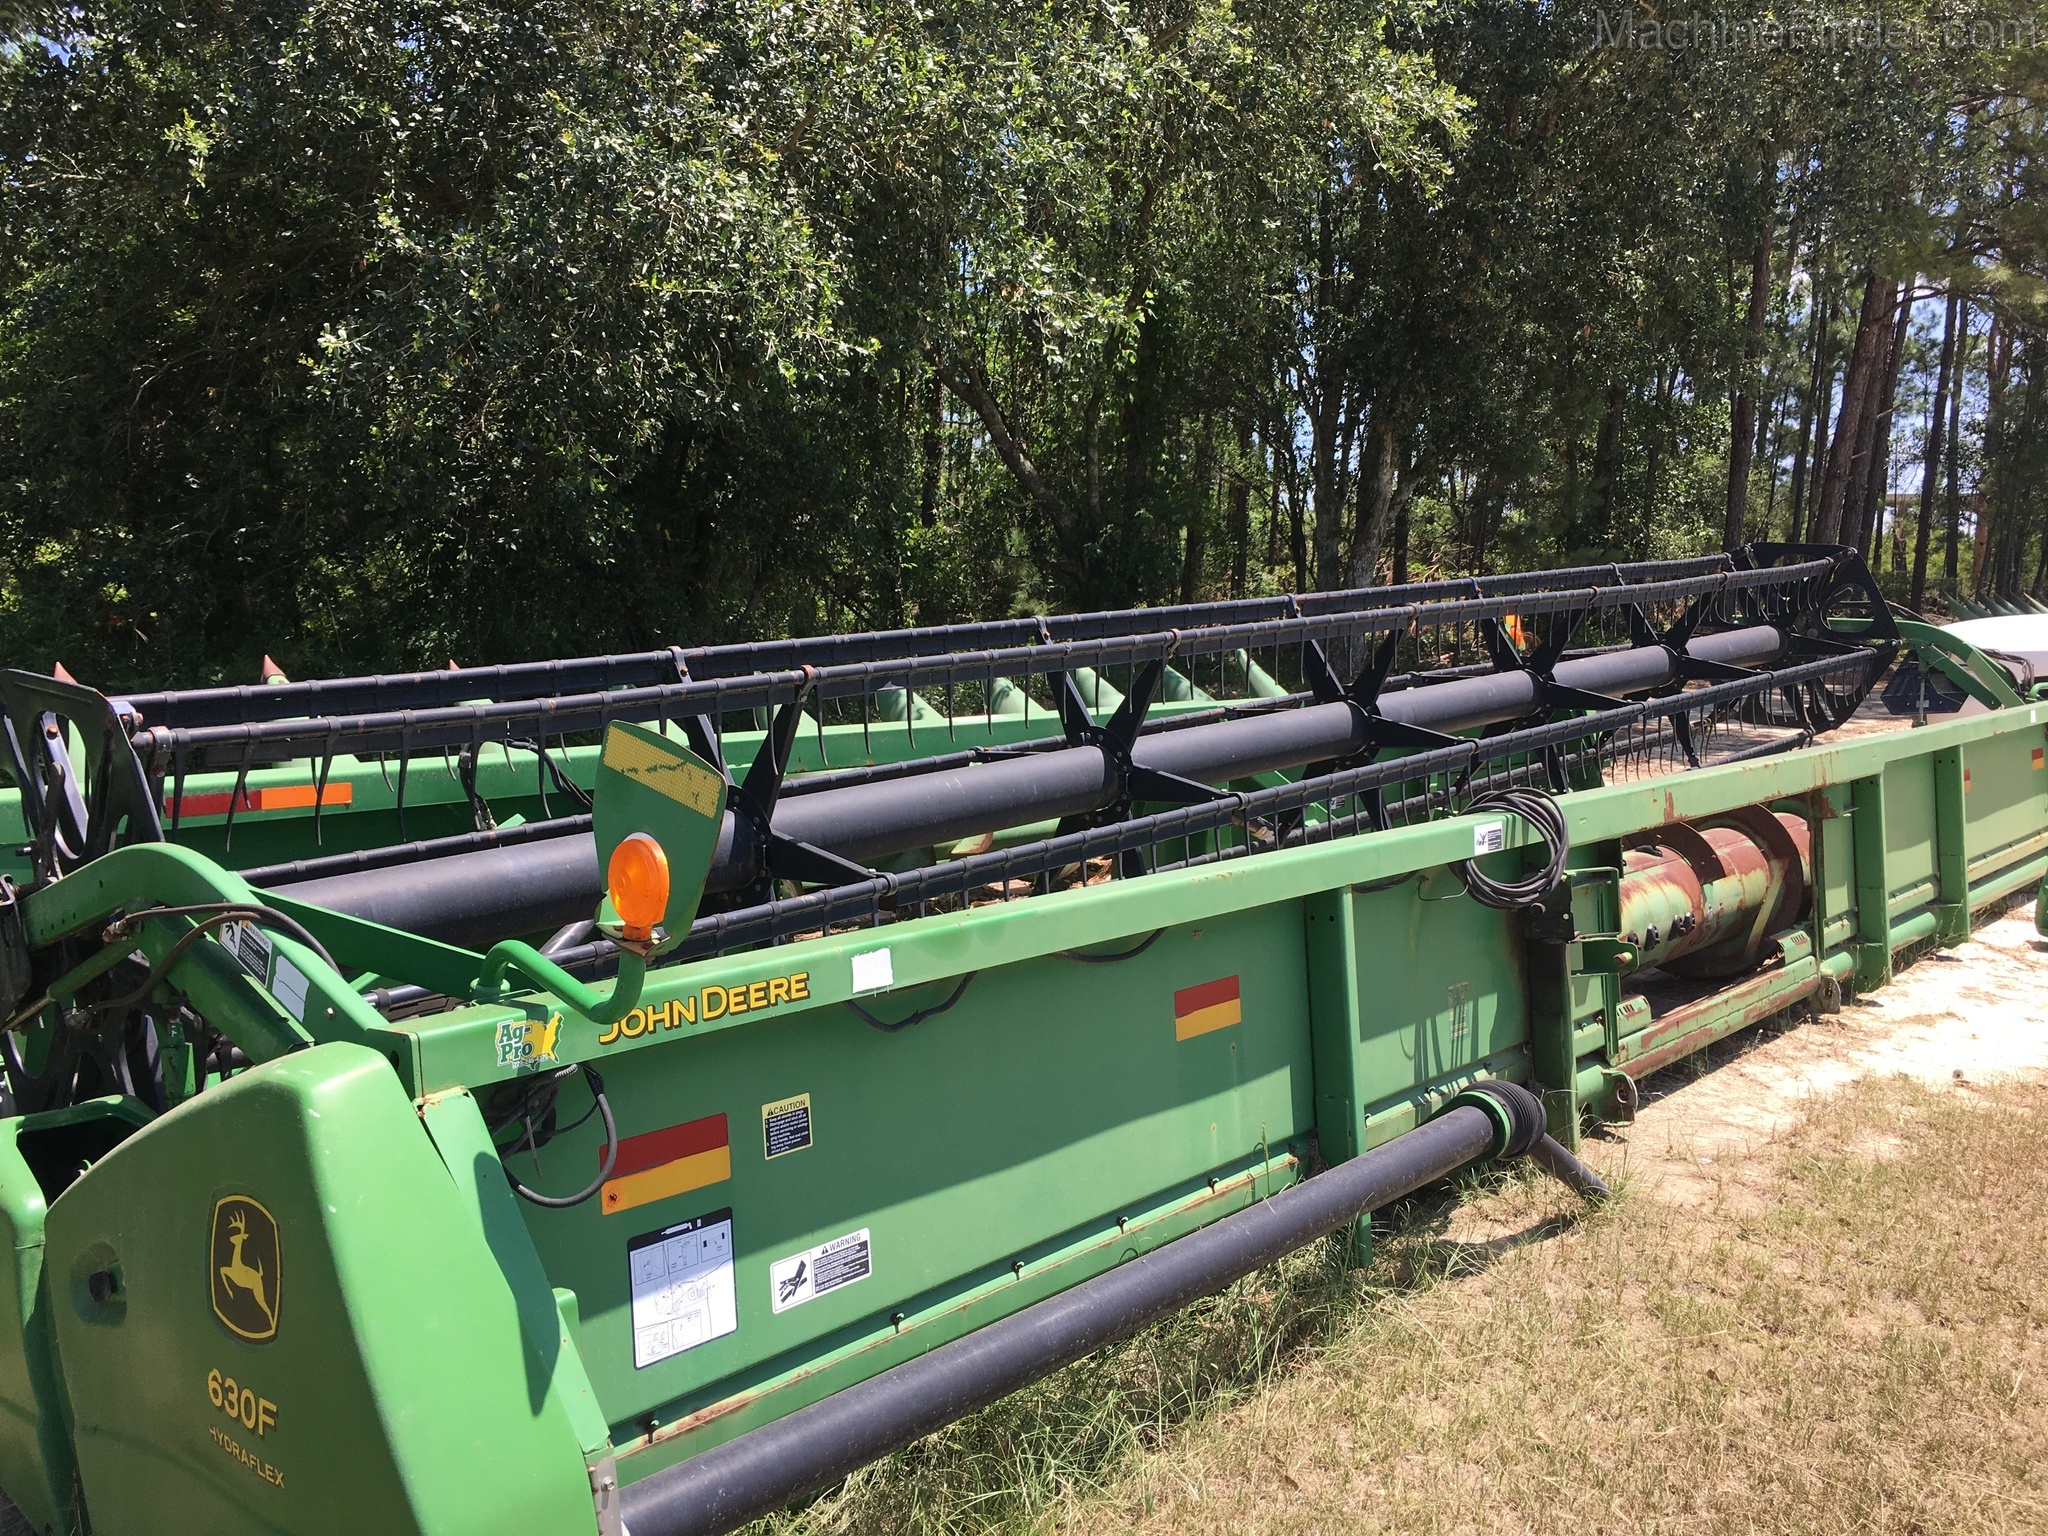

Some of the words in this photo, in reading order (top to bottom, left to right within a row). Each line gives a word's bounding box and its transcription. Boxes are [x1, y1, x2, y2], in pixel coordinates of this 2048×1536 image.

[599, 996, 697, 1044] JOHN
[701, 972, 809, 1022] DEERE
[498, 1022, 532, 1044] Ag-
[500, 1041, 533, 1064] Pro
[773, 1099, 806, 1115] CAUTION
[829, 1232, 861, 1252] WARNING
[207, 1368, 277, 1437] 630F
[209, 1425, 285, 1489] HYDRAFLEX
